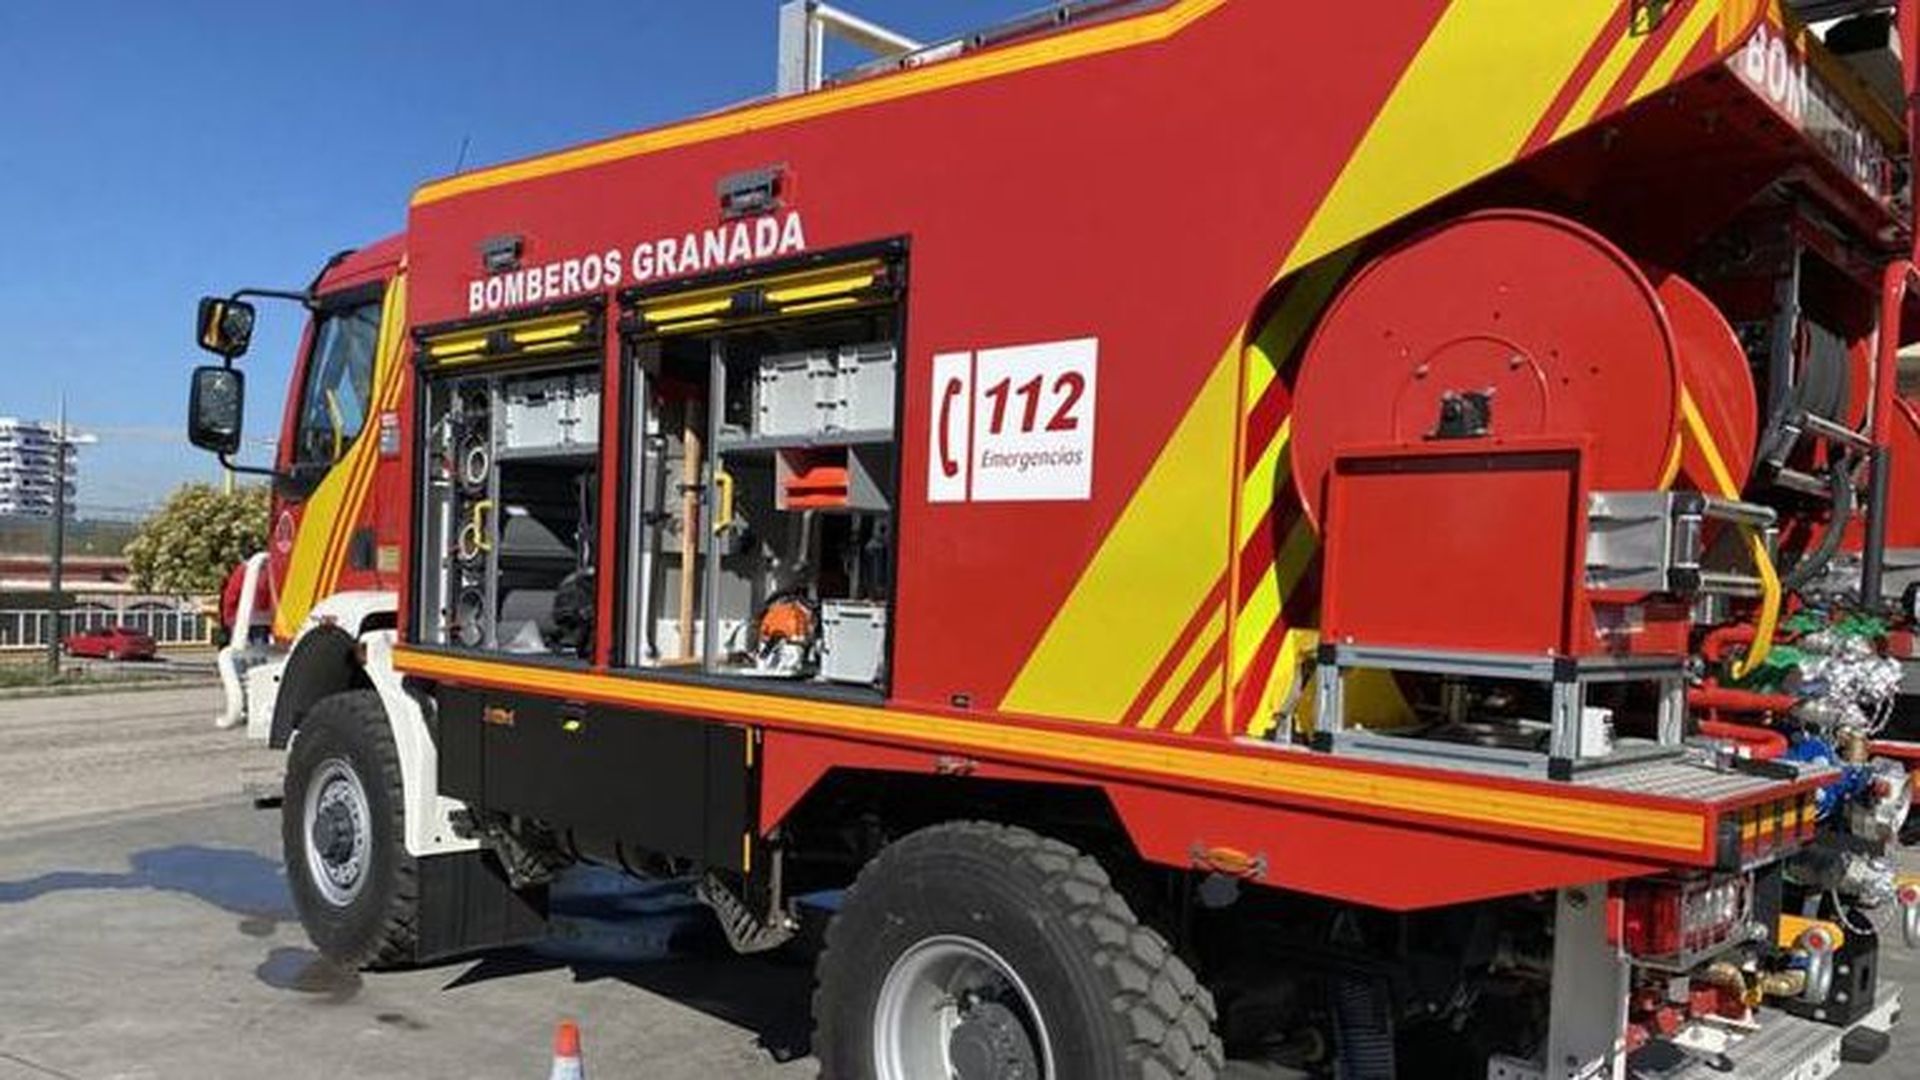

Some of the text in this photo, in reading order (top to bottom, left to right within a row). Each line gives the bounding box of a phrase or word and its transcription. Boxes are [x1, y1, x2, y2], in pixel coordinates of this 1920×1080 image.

[469, 211, 806, 314] BOMBEROS GRANADA
[984, 371, 1086, 435] 112
[981, 450, 1084, 473] Emergencias
